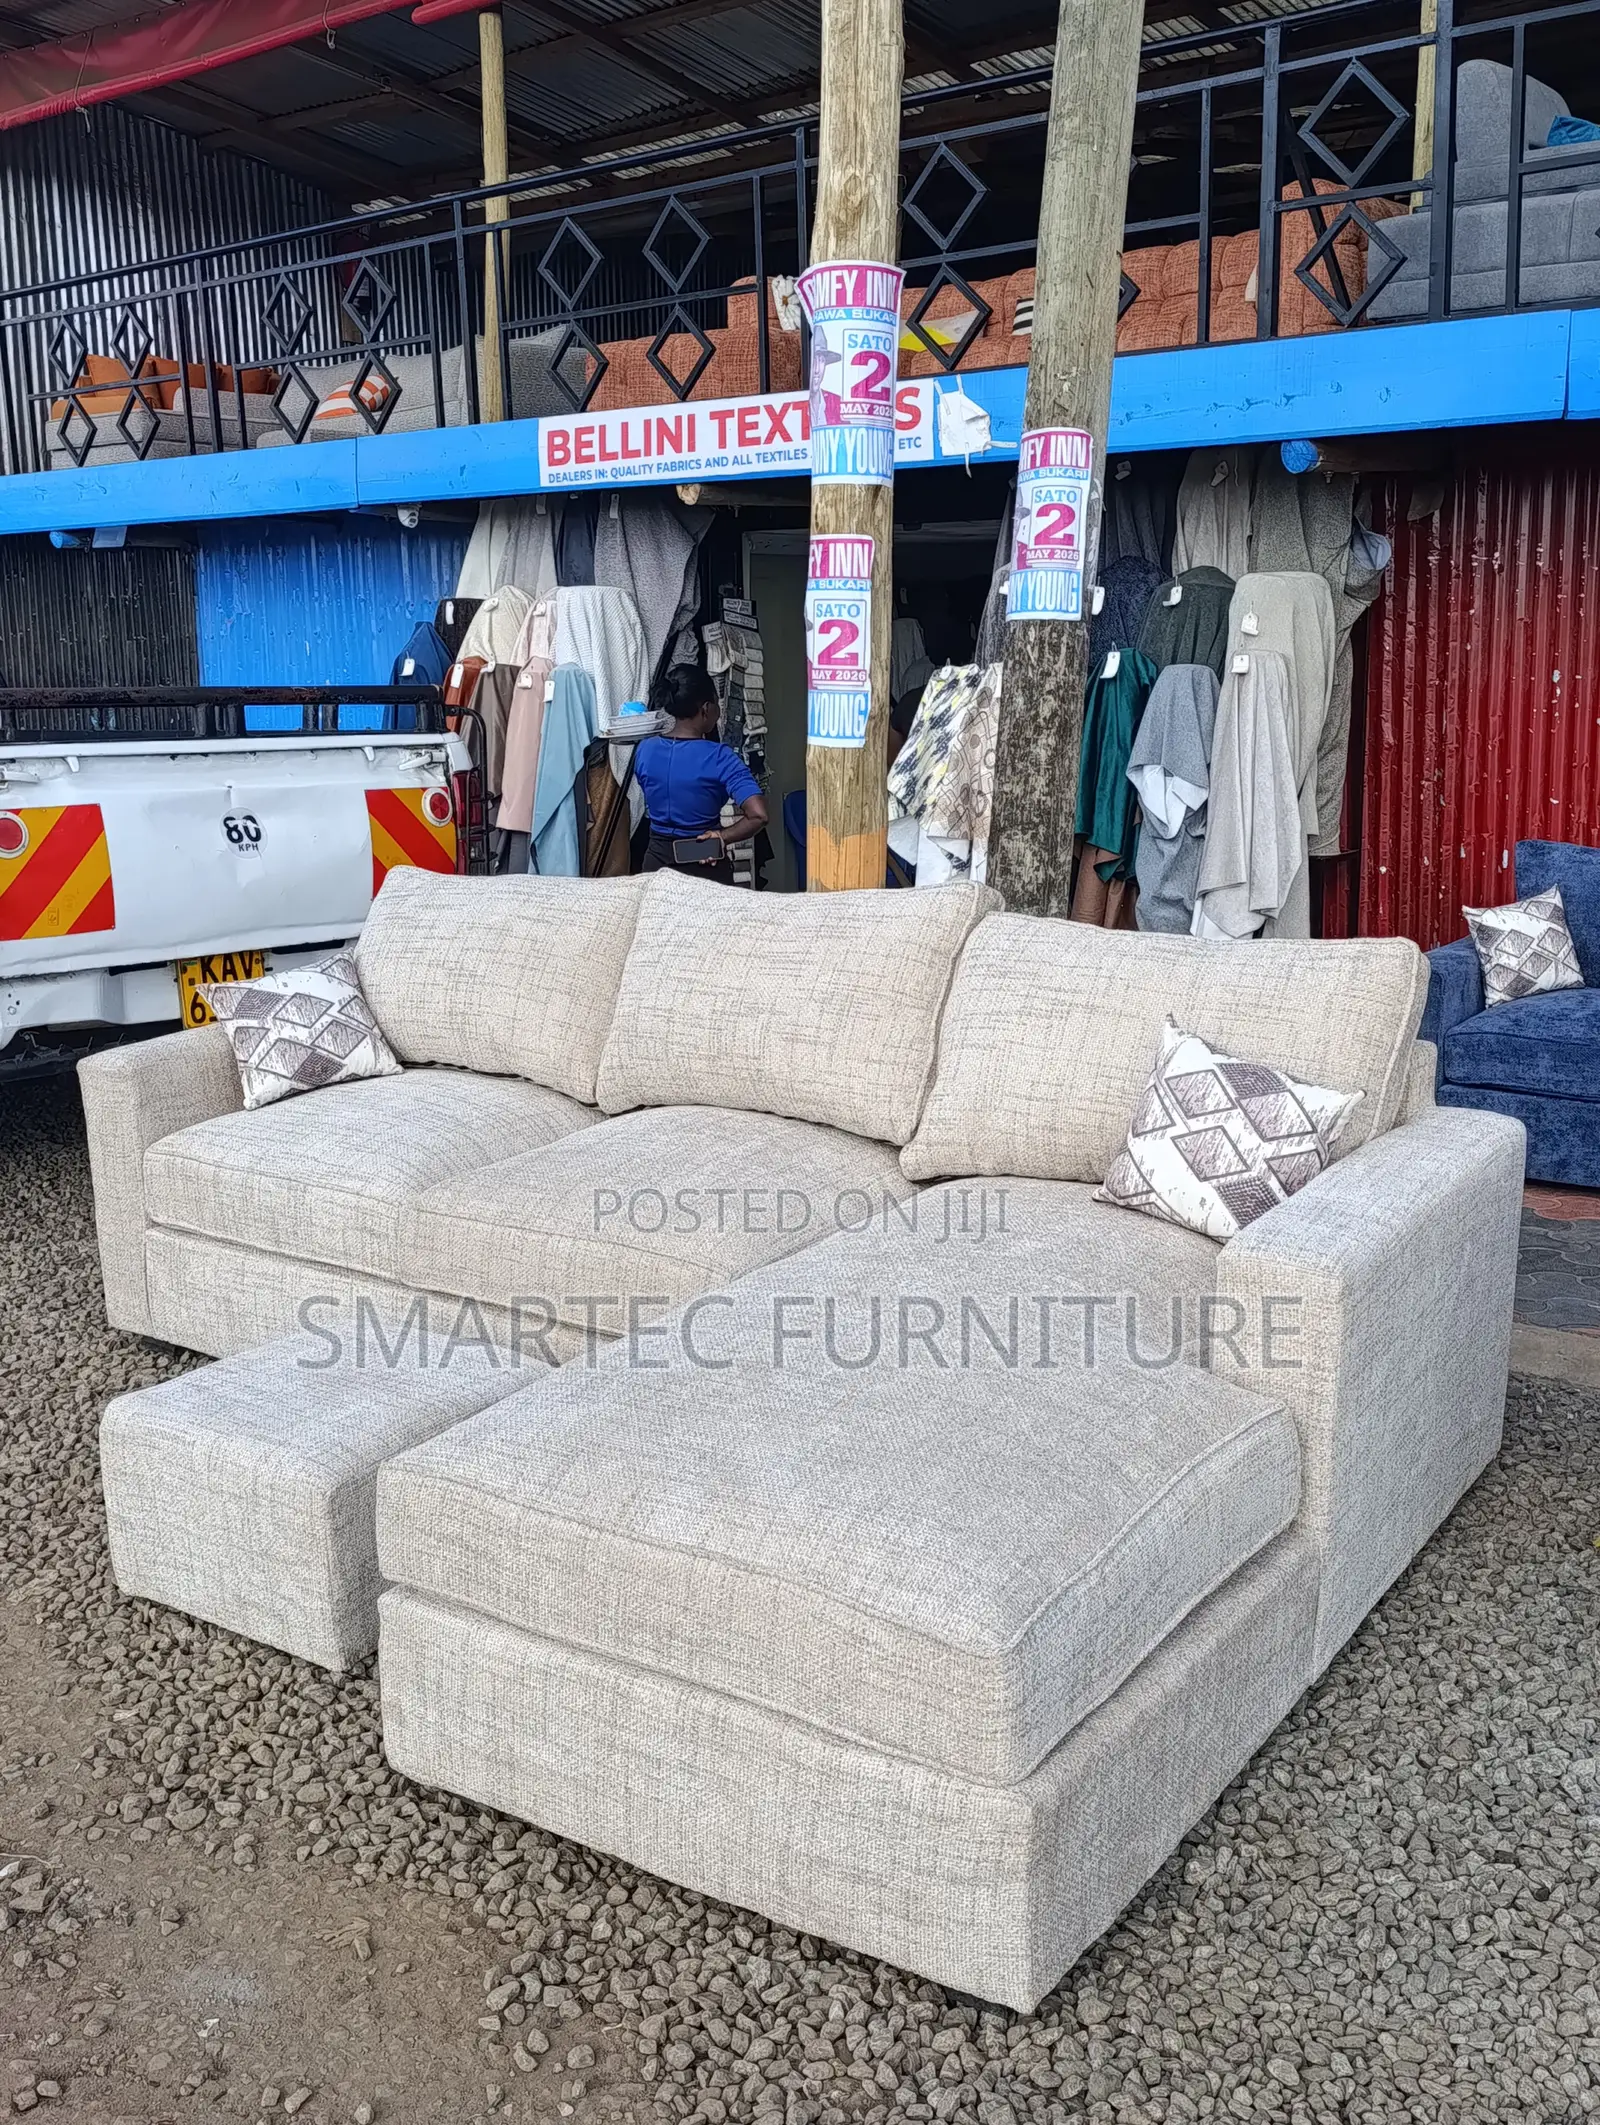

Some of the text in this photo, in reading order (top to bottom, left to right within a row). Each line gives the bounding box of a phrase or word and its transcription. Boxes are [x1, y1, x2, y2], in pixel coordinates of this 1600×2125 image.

[866, 269, 897, 311] INN
[847, 333, 892, 352] SATO
[851, 351, 890, 401] 2
[840, 403, 870, 415] MAY
[547, 413, 696, 467] BELLINI
[844, 427, 893, 479] YOUNG
[1049, 434, 1087, 468] INN
[549, 436, 922, 484] DEALERS IN: QUALITY FABRICS AND ALL TEXTILES ETC
[1038, 467, 1087, 480] SUKARI
[1034, 489, 1077, 503] SATO
[1034, 503, 1076, 546] 2
[829, 542, 869, 578] INN
[1026, 549, 1079, 561] MAY 2026
[819, 579, 871, 590] SUKARI
[1027, 570, 1078, 613] YOUNG
[816, 603, 860, 618] SATO
[818, 619, 859, 666] 2
[812, 669, 866, 681] MAY 2026
[813, 692, 866, 738] YOUNG
[238, 843, 260, 852] KPH
[200, 951, 254, 984] KAV
